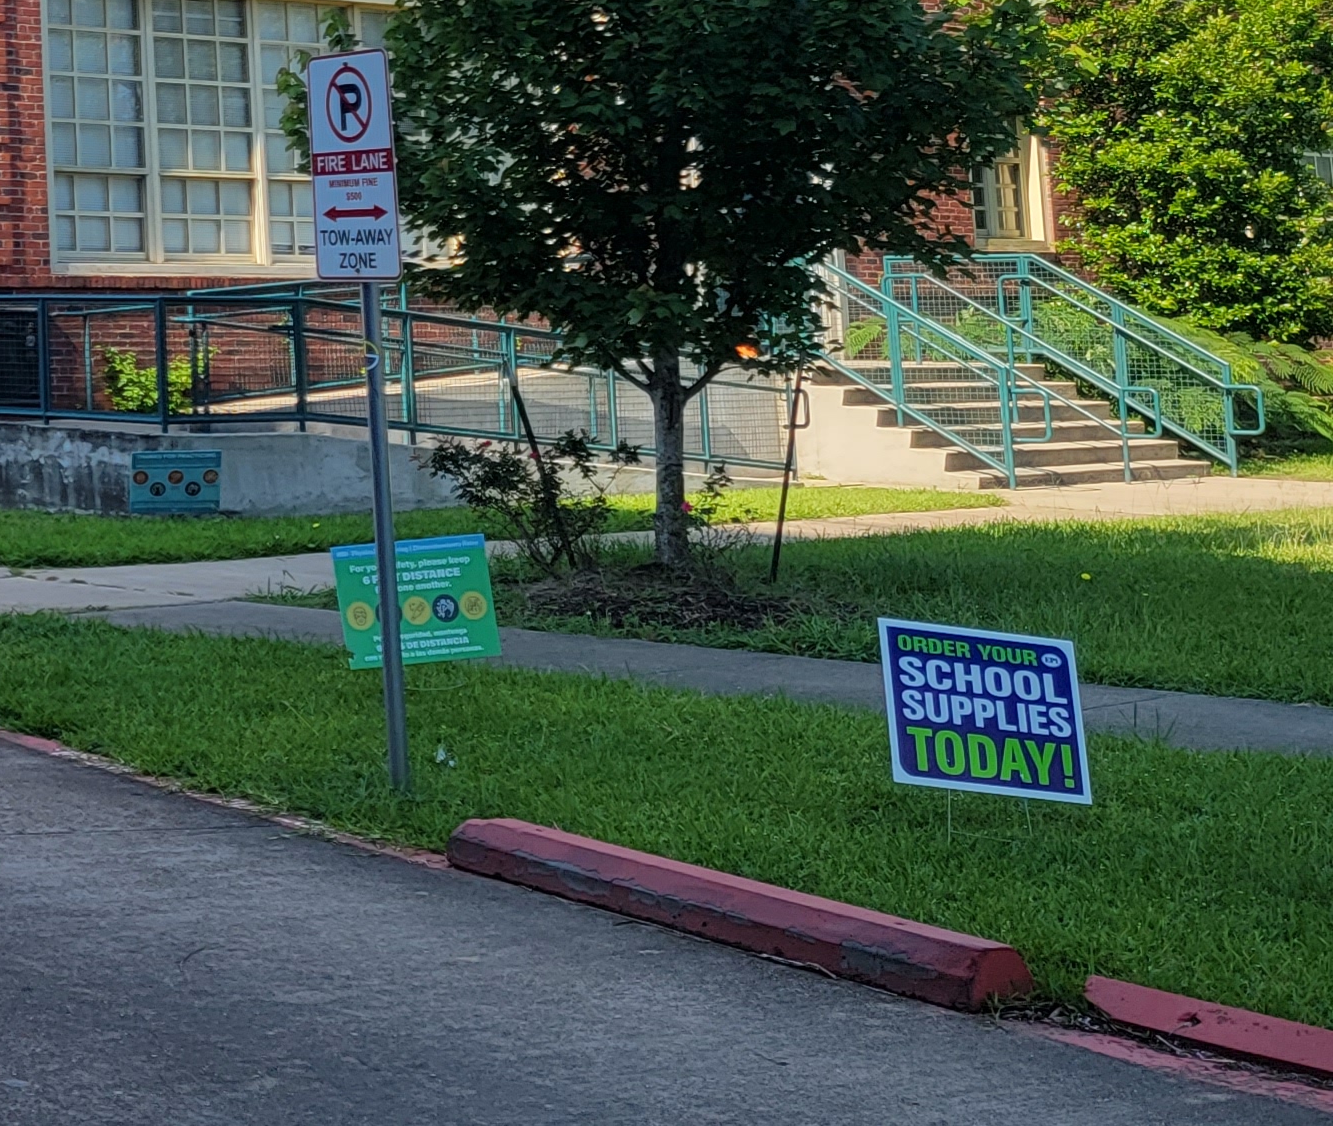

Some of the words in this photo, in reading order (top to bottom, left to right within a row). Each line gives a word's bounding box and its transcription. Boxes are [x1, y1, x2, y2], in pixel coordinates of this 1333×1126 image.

[317, 155, 346, 173] FIRE
[352, 152, 388, 170] LANE
[329, 178, 360, 189] MINIMUM
[362, 177, 378, 187] FINE
[320, 228, 393, 247] TOW-AWAY
[339, 252, 377, 270] ZONE
[418, 558, 447, 568] please
[448, 556, 470, 564] keep
[362, 576, 371, 585] 6
[402, 567, 462, 582] DISTANCE
[420, 636, 470, 648] DISTANCIA
[897, 634, 971, 658] ORDER
[976, 643, 1038, 666] YOUR
[898, 656, 1068, 704] SCHOOL
[901, 689, 1072, 738] SUPPLIES
[906, 726, 1075, 788] TODAY!
